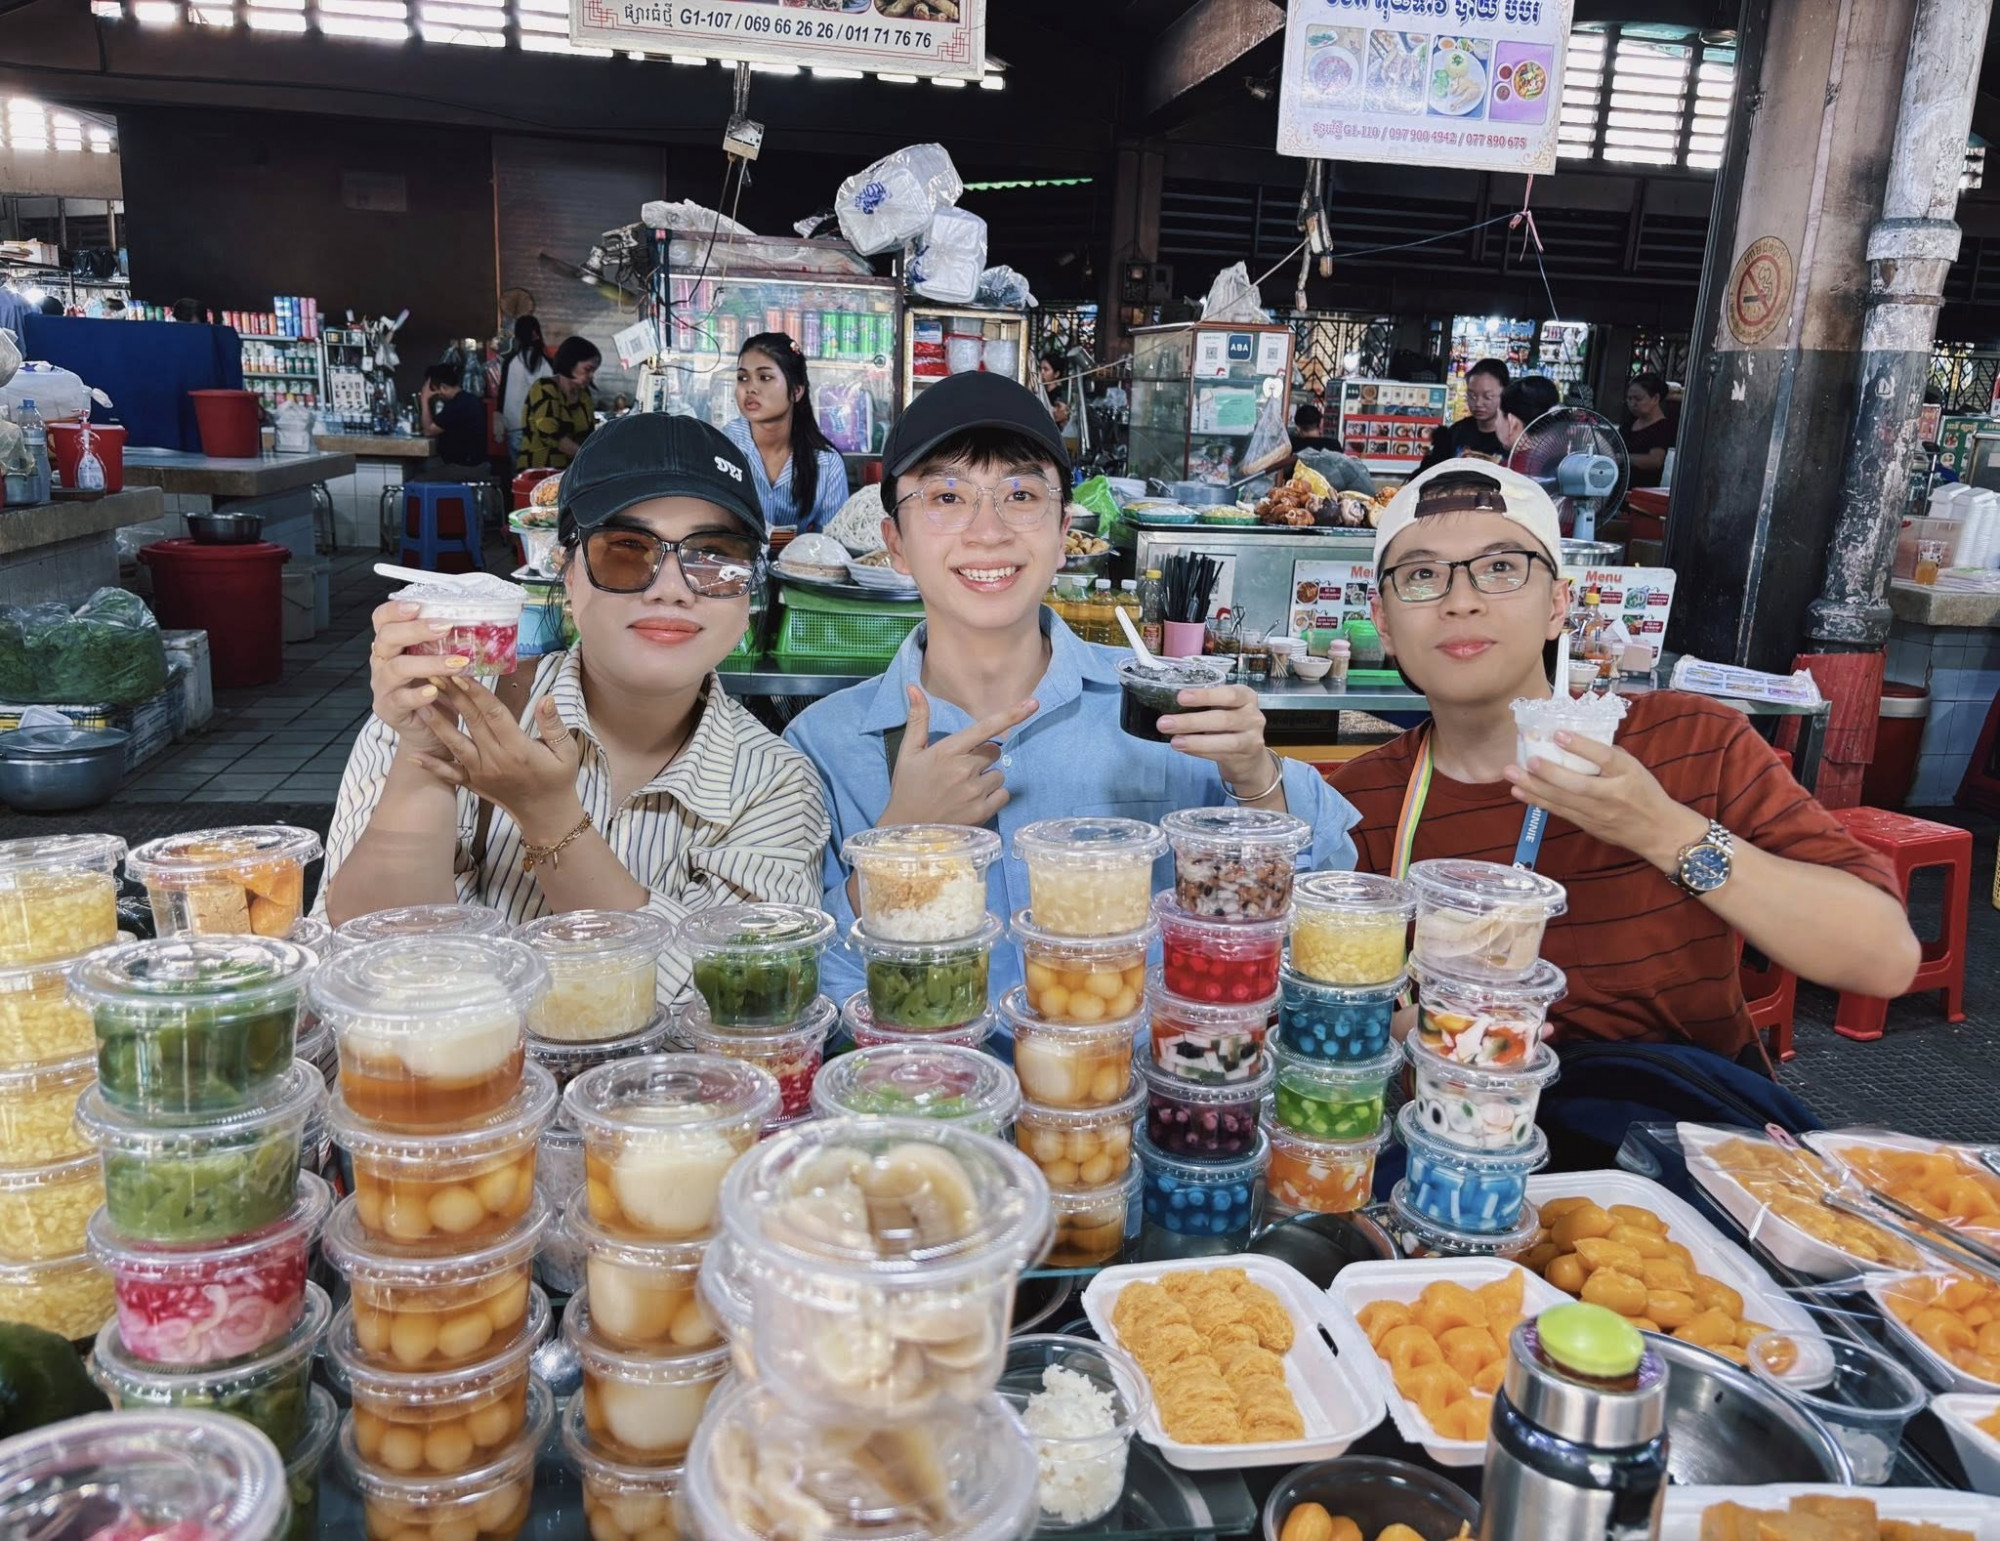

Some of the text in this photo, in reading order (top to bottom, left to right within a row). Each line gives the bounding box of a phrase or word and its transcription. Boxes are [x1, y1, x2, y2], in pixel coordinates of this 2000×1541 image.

[680, 8, 733, 29] G1-107
[744, 15, 771, 33] 069
[774, 18, 792, 35] 66
[796, 20, 813, 37] 26
[816, 22, 834, 39] 26
[845, 25, 870, 42] 011
[873, 28, 889, 44] 71
[894, 29, 911, 46] 76
[914, 31, 932, 48] 76
[1466, 133, 1487, 146] 077
[1487, 135, 1506, 149] 890
[1507, 136, 1528, 150] 675
[1230, 343, 1249, 352] ABA
[1350, 565, 1374, 579] Me
[1585, 570, 1622, 583] Menu
